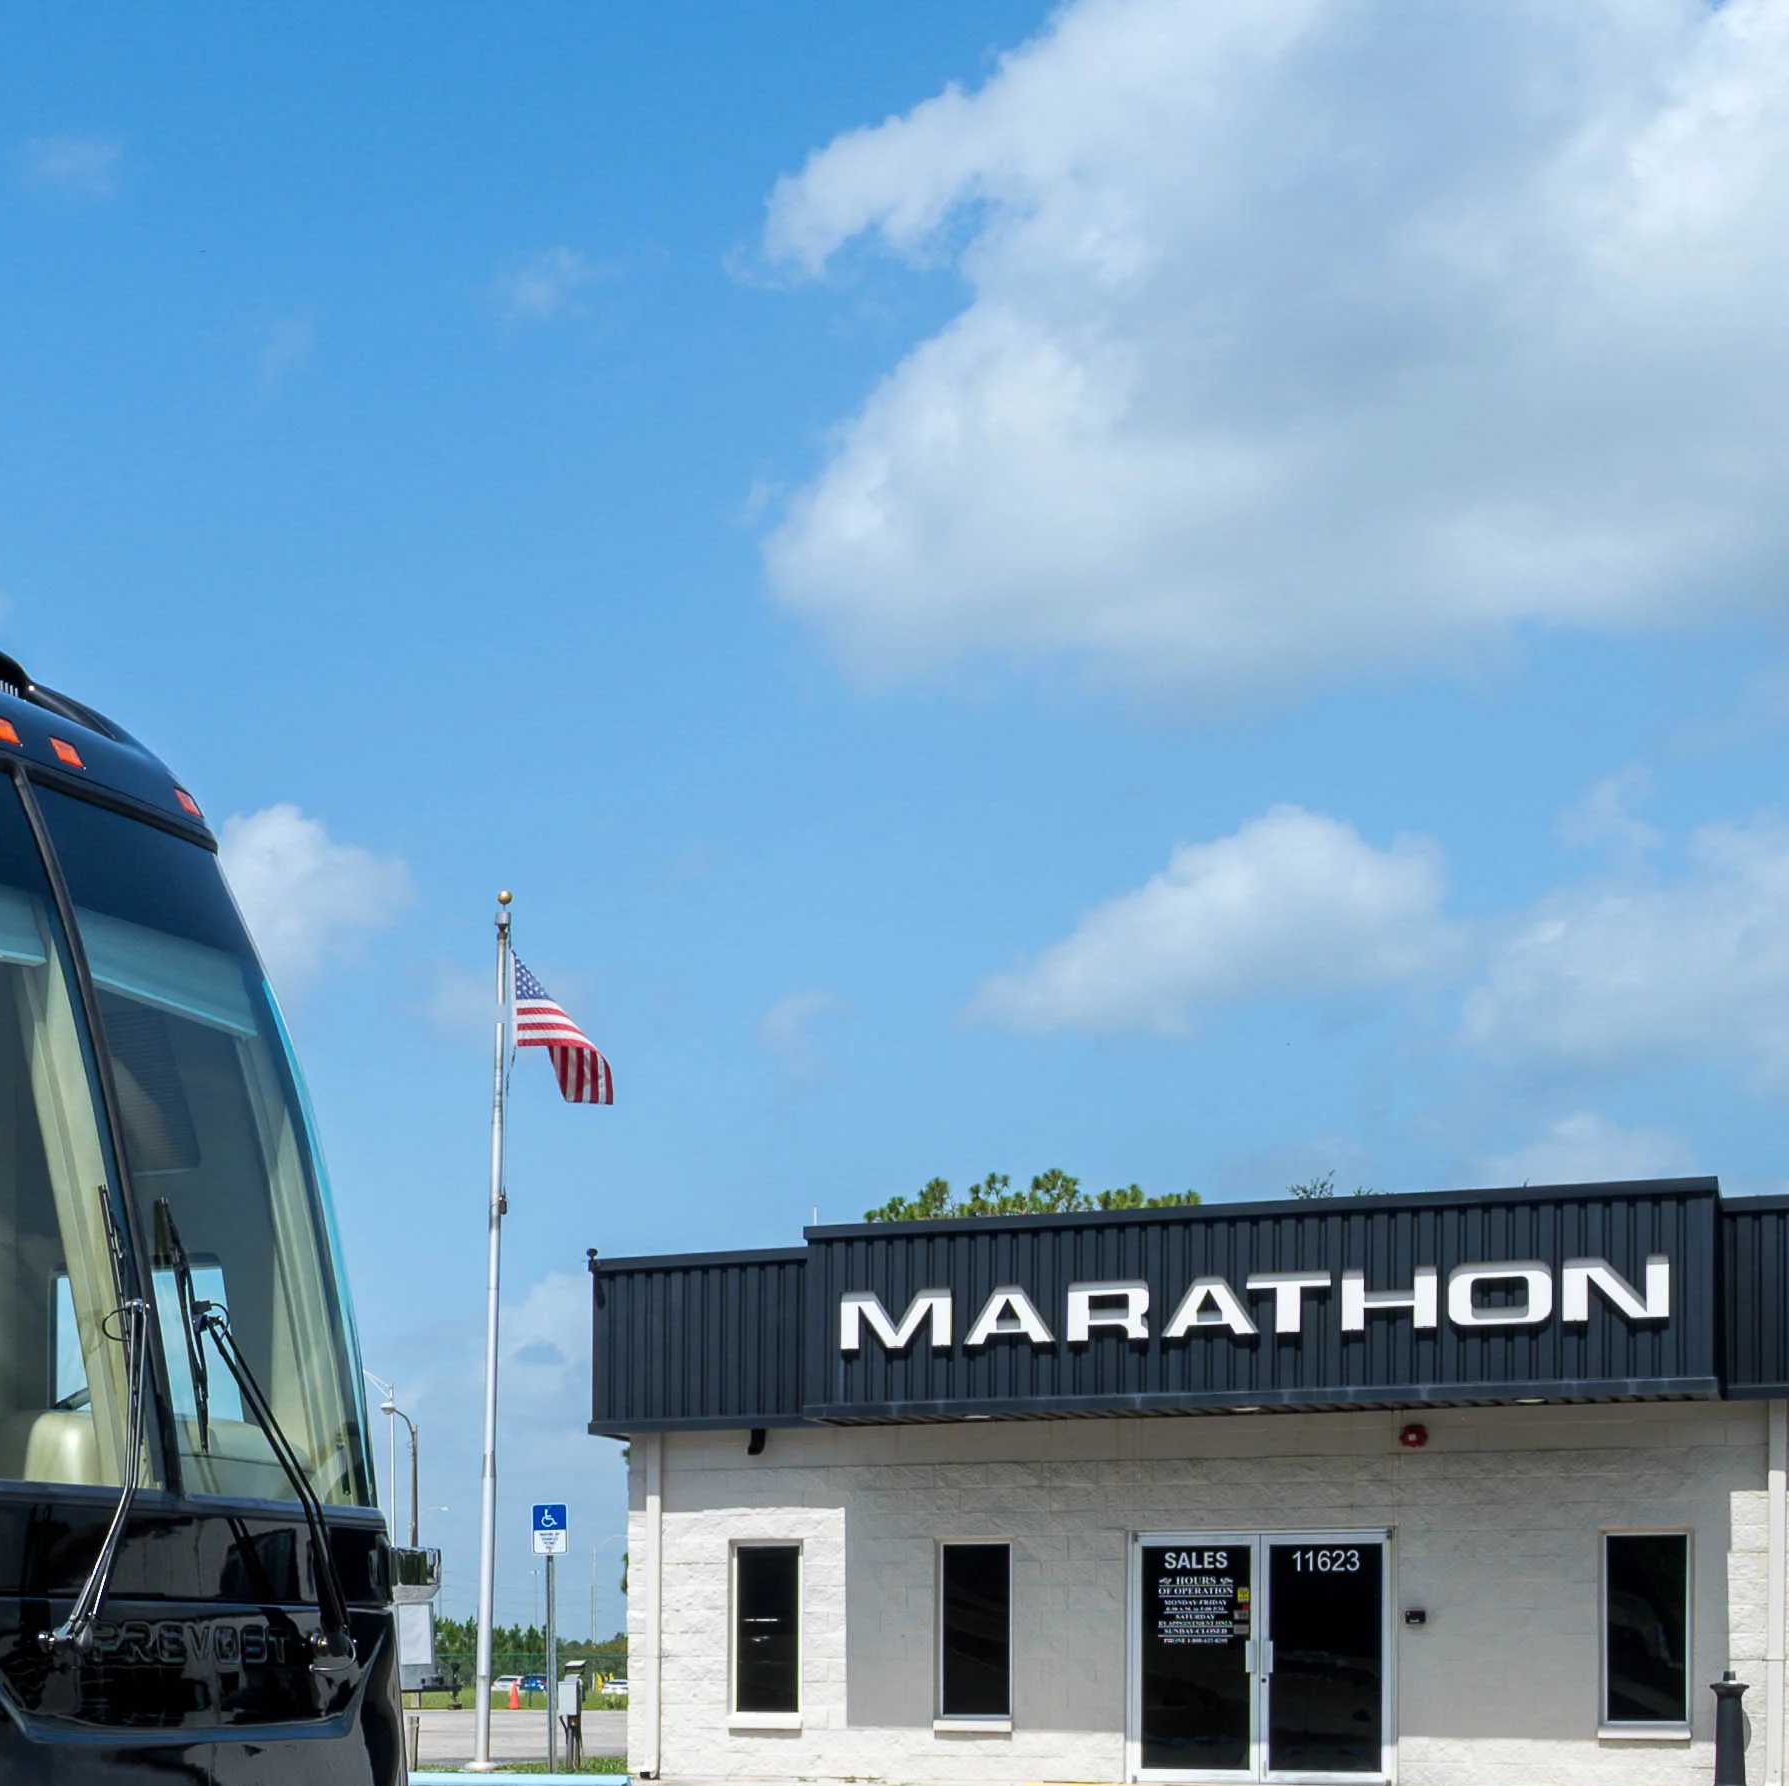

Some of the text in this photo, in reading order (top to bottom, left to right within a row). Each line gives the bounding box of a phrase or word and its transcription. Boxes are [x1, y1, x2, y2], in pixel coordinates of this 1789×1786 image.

[839, 1254, 1671, 1350] MARATHON
[1164, 1552, 1228, 1569] SALES
[1292, 1549, 1360, 1572] 11623
[1158, 1587, 1172, 1595] OF
[1174, 1586, 1233, 1595] OPERATION
[1176, 1576, 1217, 1585] HOURS
[92, 1618, 291, 1665] PREVOST
